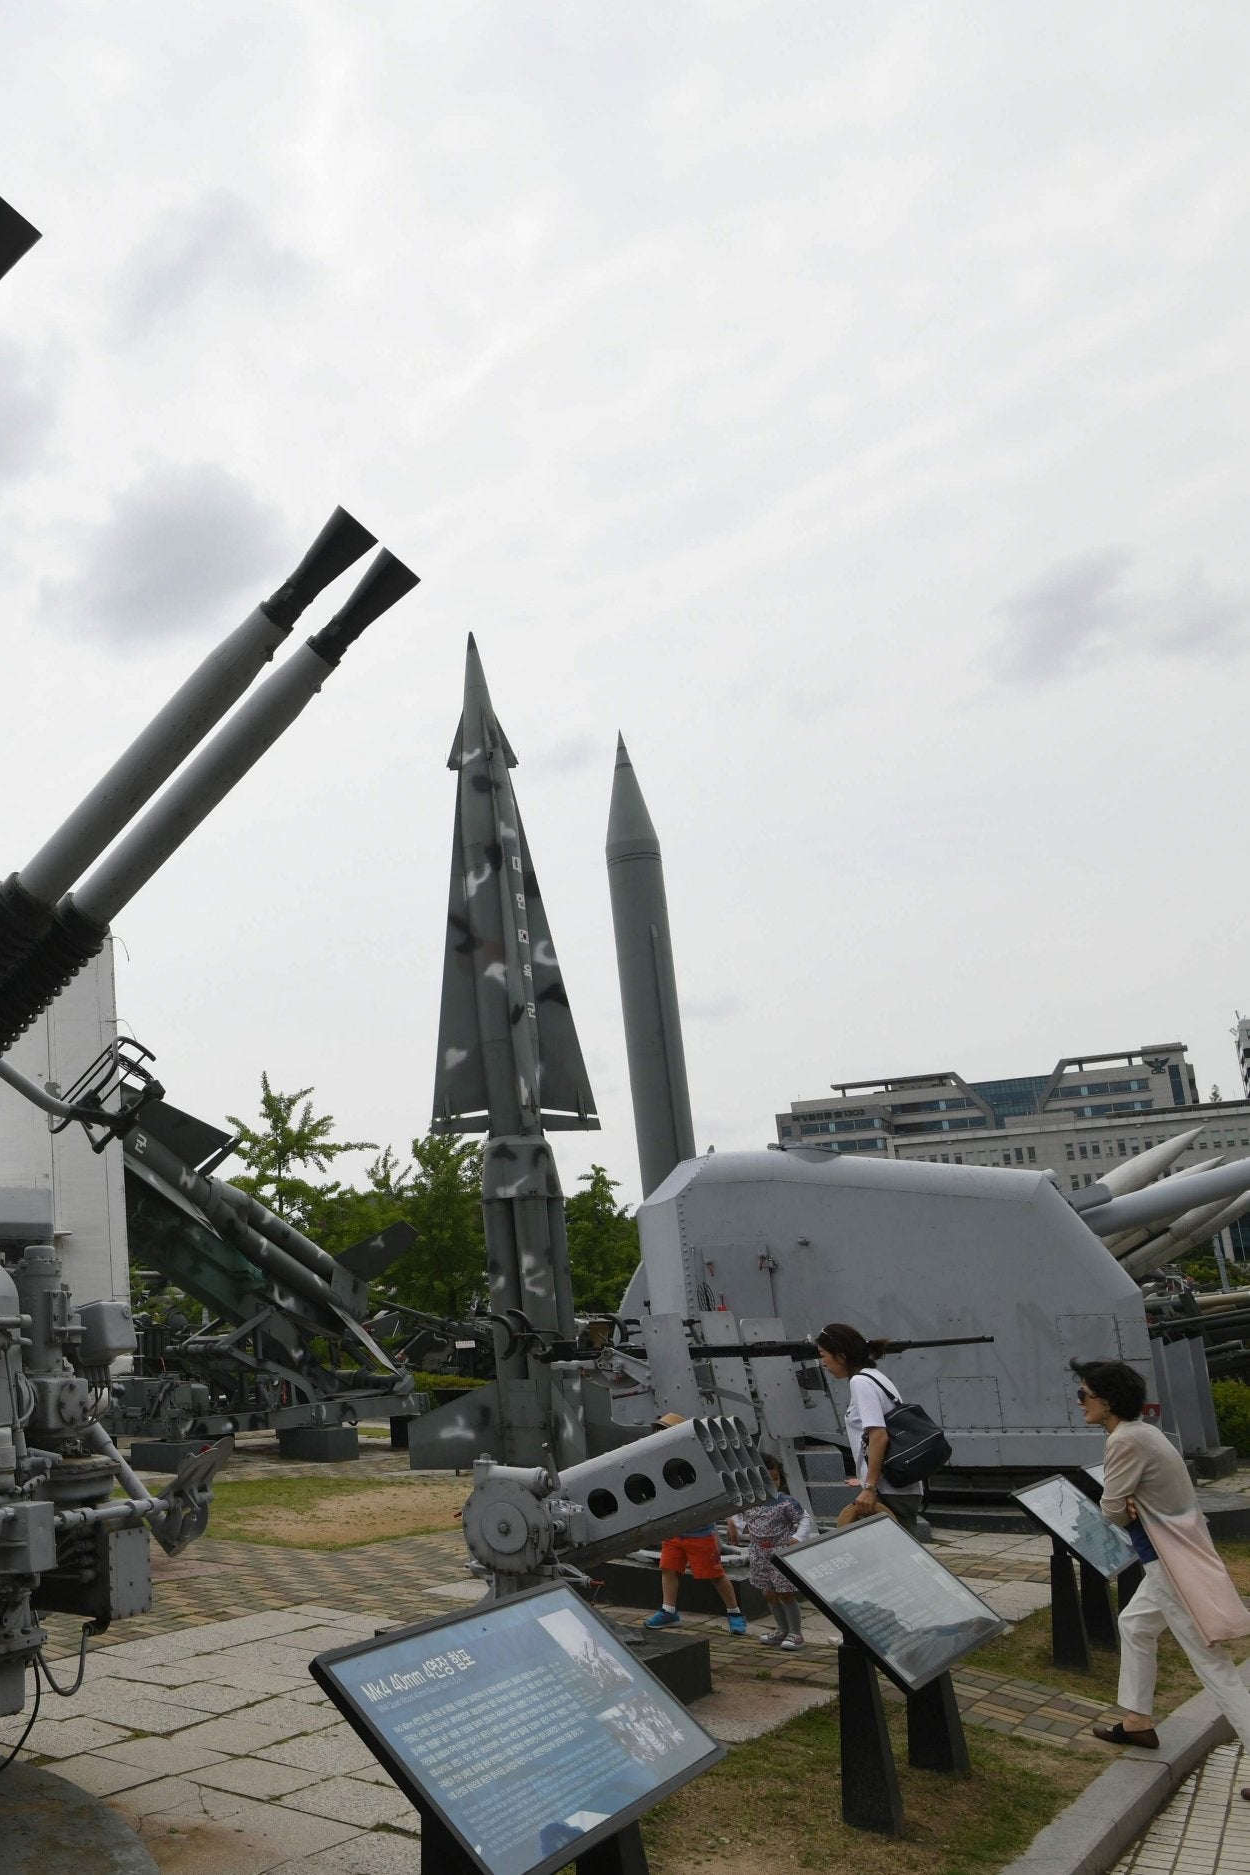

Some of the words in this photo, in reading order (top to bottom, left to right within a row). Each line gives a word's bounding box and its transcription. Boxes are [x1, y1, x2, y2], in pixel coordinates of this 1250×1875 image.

[360, 1678, 393, 1702] Mk4
[389, 1670, 427, 1692] 40mm
[421, 1655, 455, 1679] 4연장
[446, 1649, 477, 1671] 함포
